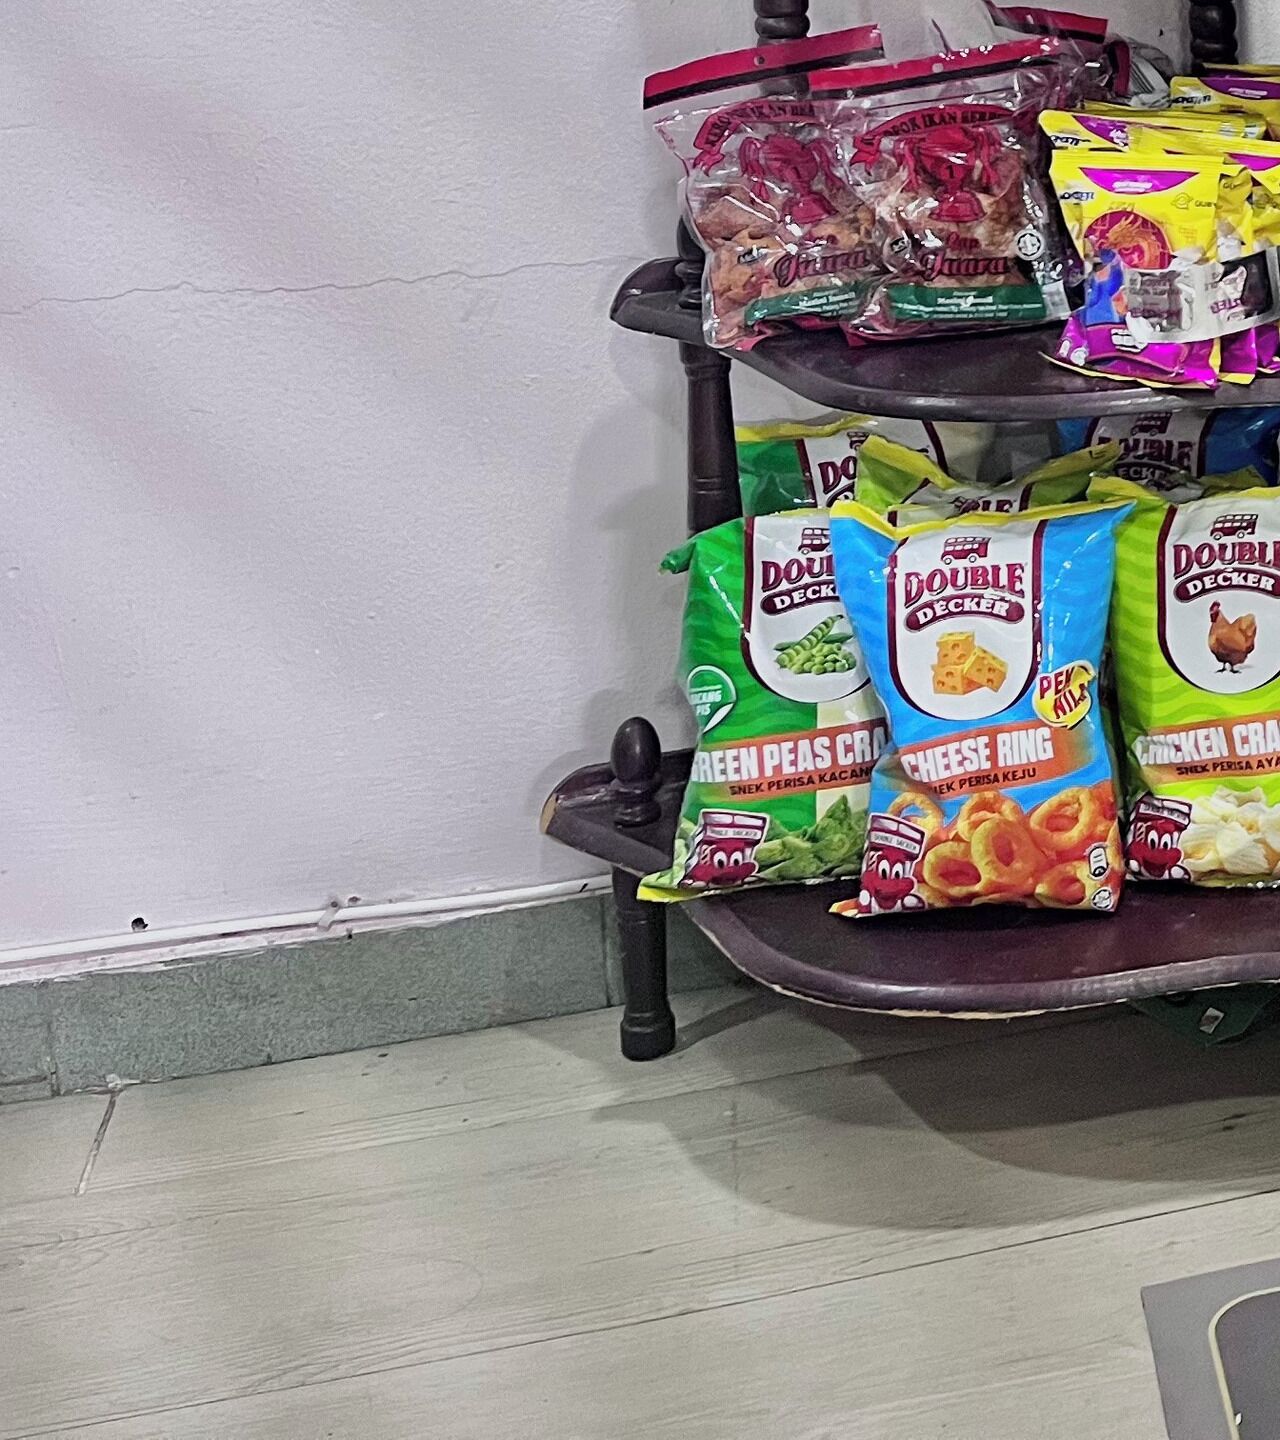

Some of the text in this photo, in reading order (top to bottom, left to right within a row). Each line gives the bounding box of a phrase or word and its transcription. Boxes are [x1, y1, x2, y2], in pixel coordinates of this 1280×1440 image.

[761, 556, 834, 591] DOU
[904, 564, 1026, 608] DOUBLE
[1186, 571, 1276, 598] DECKER
[773, 584, 838, 610] DECK
[915, 599, 1010, 626] DECKER
[763, 735, 832, 776] PEAS
[901, 727, 1054, 784] CHEESE RING
[1134, 725, 1229, 766] CHICKEN
[1212, 759, 1252, 773] PERISA
[729, 781, 764, 796] SNEK
[767, 773, 815, 792] PERISA
[958, 775, 1000, 793] PERISA
[1003, 767, 1037, 783] KEJU
